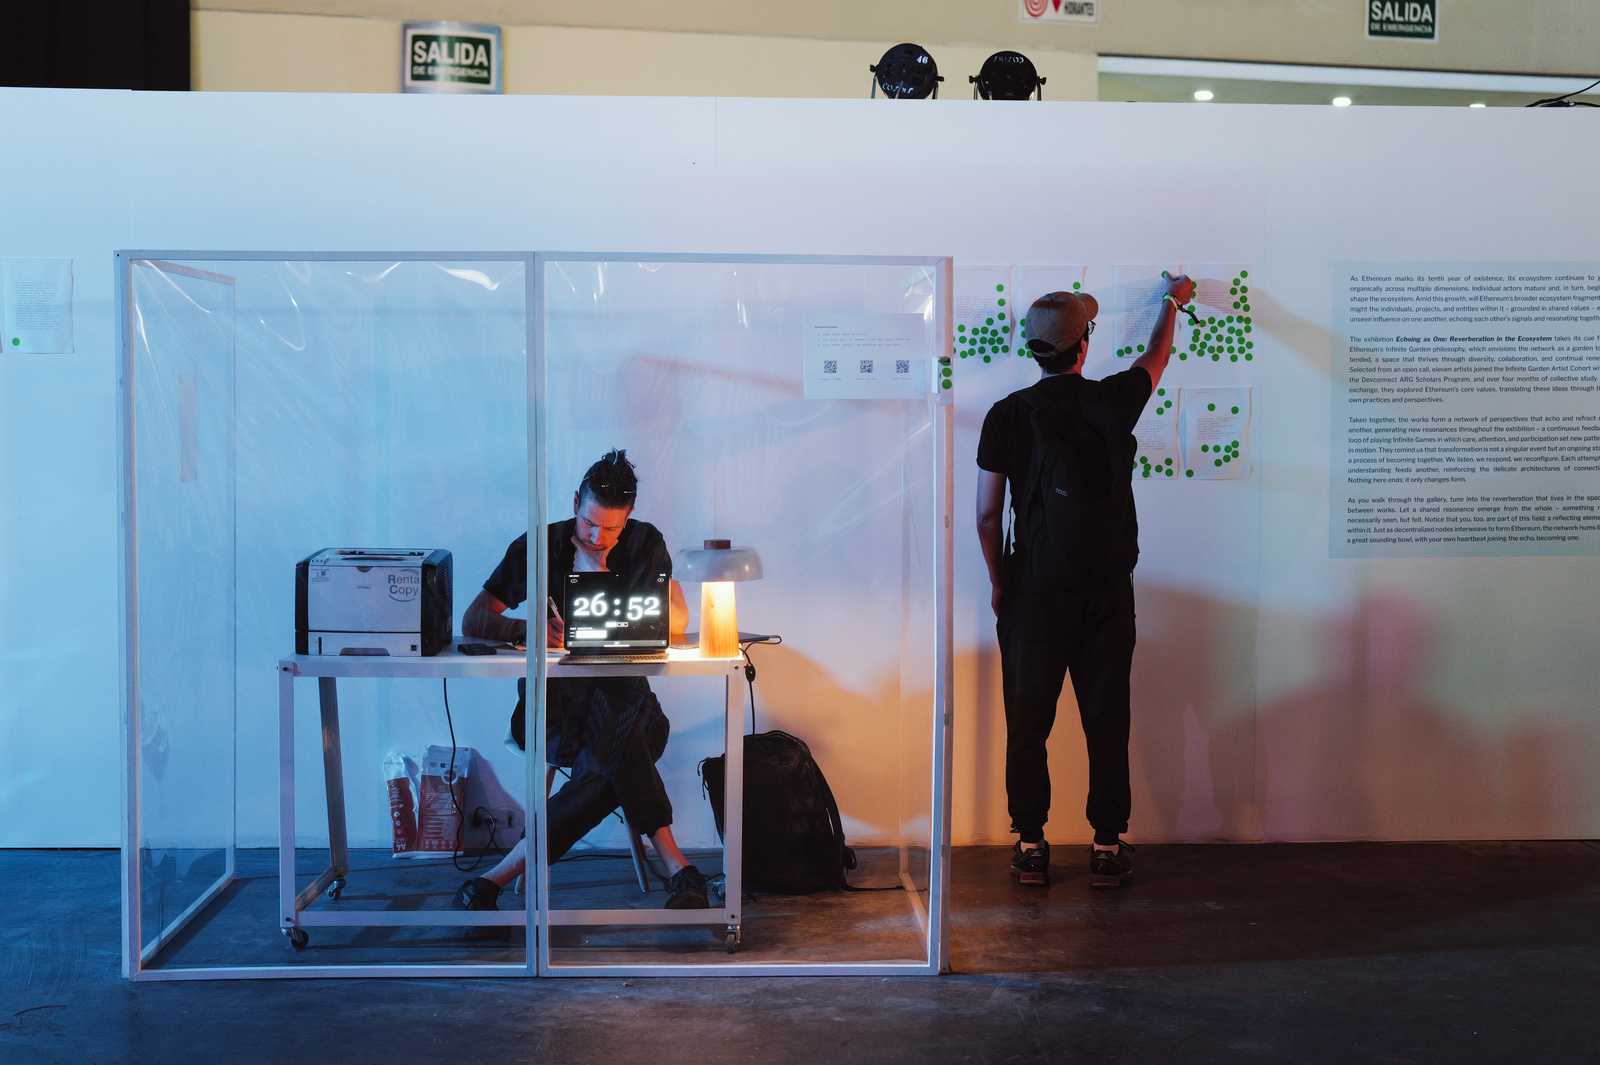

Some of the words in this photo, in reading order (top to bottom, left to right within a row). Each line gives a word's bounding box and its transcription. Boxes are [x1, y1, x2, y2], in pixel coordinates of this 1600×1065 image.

[1371, 1, 1433, 23] SALIDA
[1370, 22, 1381, 31] DE
[1383, 22, 1433, 33] EMERGENCIA
[413, 40, 489, 67] SALIDA
[916, 55, 929, 64] 46
[412, 65, 426, 75] DE
[1474, 274, 1505, 283] existence,
[1519, 274, 1551, 283] ecosystem
[1350, 295, 1368, 304] shape
[1380, 295, 1414, 304] ecosystem.
[1445, 295, 1467, 303] growth,
[1539, 294, 1572, 303] ecosystem
[1423, 315, 1448, 324] another,
[1449, 315, 1473, 324] echoing
[1512, 315, 1532, 324] signals
[1546, 315, 1578, 323] resonating
[1396, 335, 1421, 344] Echoing
[1518, 335, 1552, 344] Ecosystem
[1350, 356, 1372, 364] tended,
[1442, 355, 1465, 364] through
[1468, 355, 1495, 364] diversity,
[1498, 355, 1539, 364] collaboration,
[1349, 386, 1379, 395] exchange,
[1381, 386, 1395, 395] they
[1397, 386, 1423, 394] explored
[1476, 386, 1497, 394] values,
[1499, 386, 1531, 394] translating
[1570, 385, 1594, 394] through
[1363, 396, 1390, 405] practices
[1404, 396, 1444, 405] perspectives.
[1348, 426, 1373, 435] another,
[1374, 426, 1407, 435] generating
[1459, 426, 1492, 434] throughout
[1386, 456, 1416, 465] becoming
[1417, 456, 1444, 464] together.
[1457, 456, 1474, 464] listen,
[1486, 456, 1512, 464] respond,
[1524, 455, 1559, 464] reconfigure.
[1348, 467, 1391, 475] understanding
[1416, 466, 1440, 475] another,
[1444, 466, 1476, 474] reinforcing
[1348, 477, 1372, 485] Nothing
[1411, 476, 1423, 485] only
[1424, 476, 1449, 485] changes
[1511, 525, 1541, 533] Ethereum,
[1352, 537, 1368, 545] great
[1369, 536, 1396, 545] sounding
[1398, 536, 1413, 545] bowl,
[1487, 535, 1507, 544] joining
[1519, 534, 1535, 543] echo,
[1537, 534, 1566, 543] becoming
[388, 574, 420, 584] Renta
[389, 584, 419, 597] Copy
